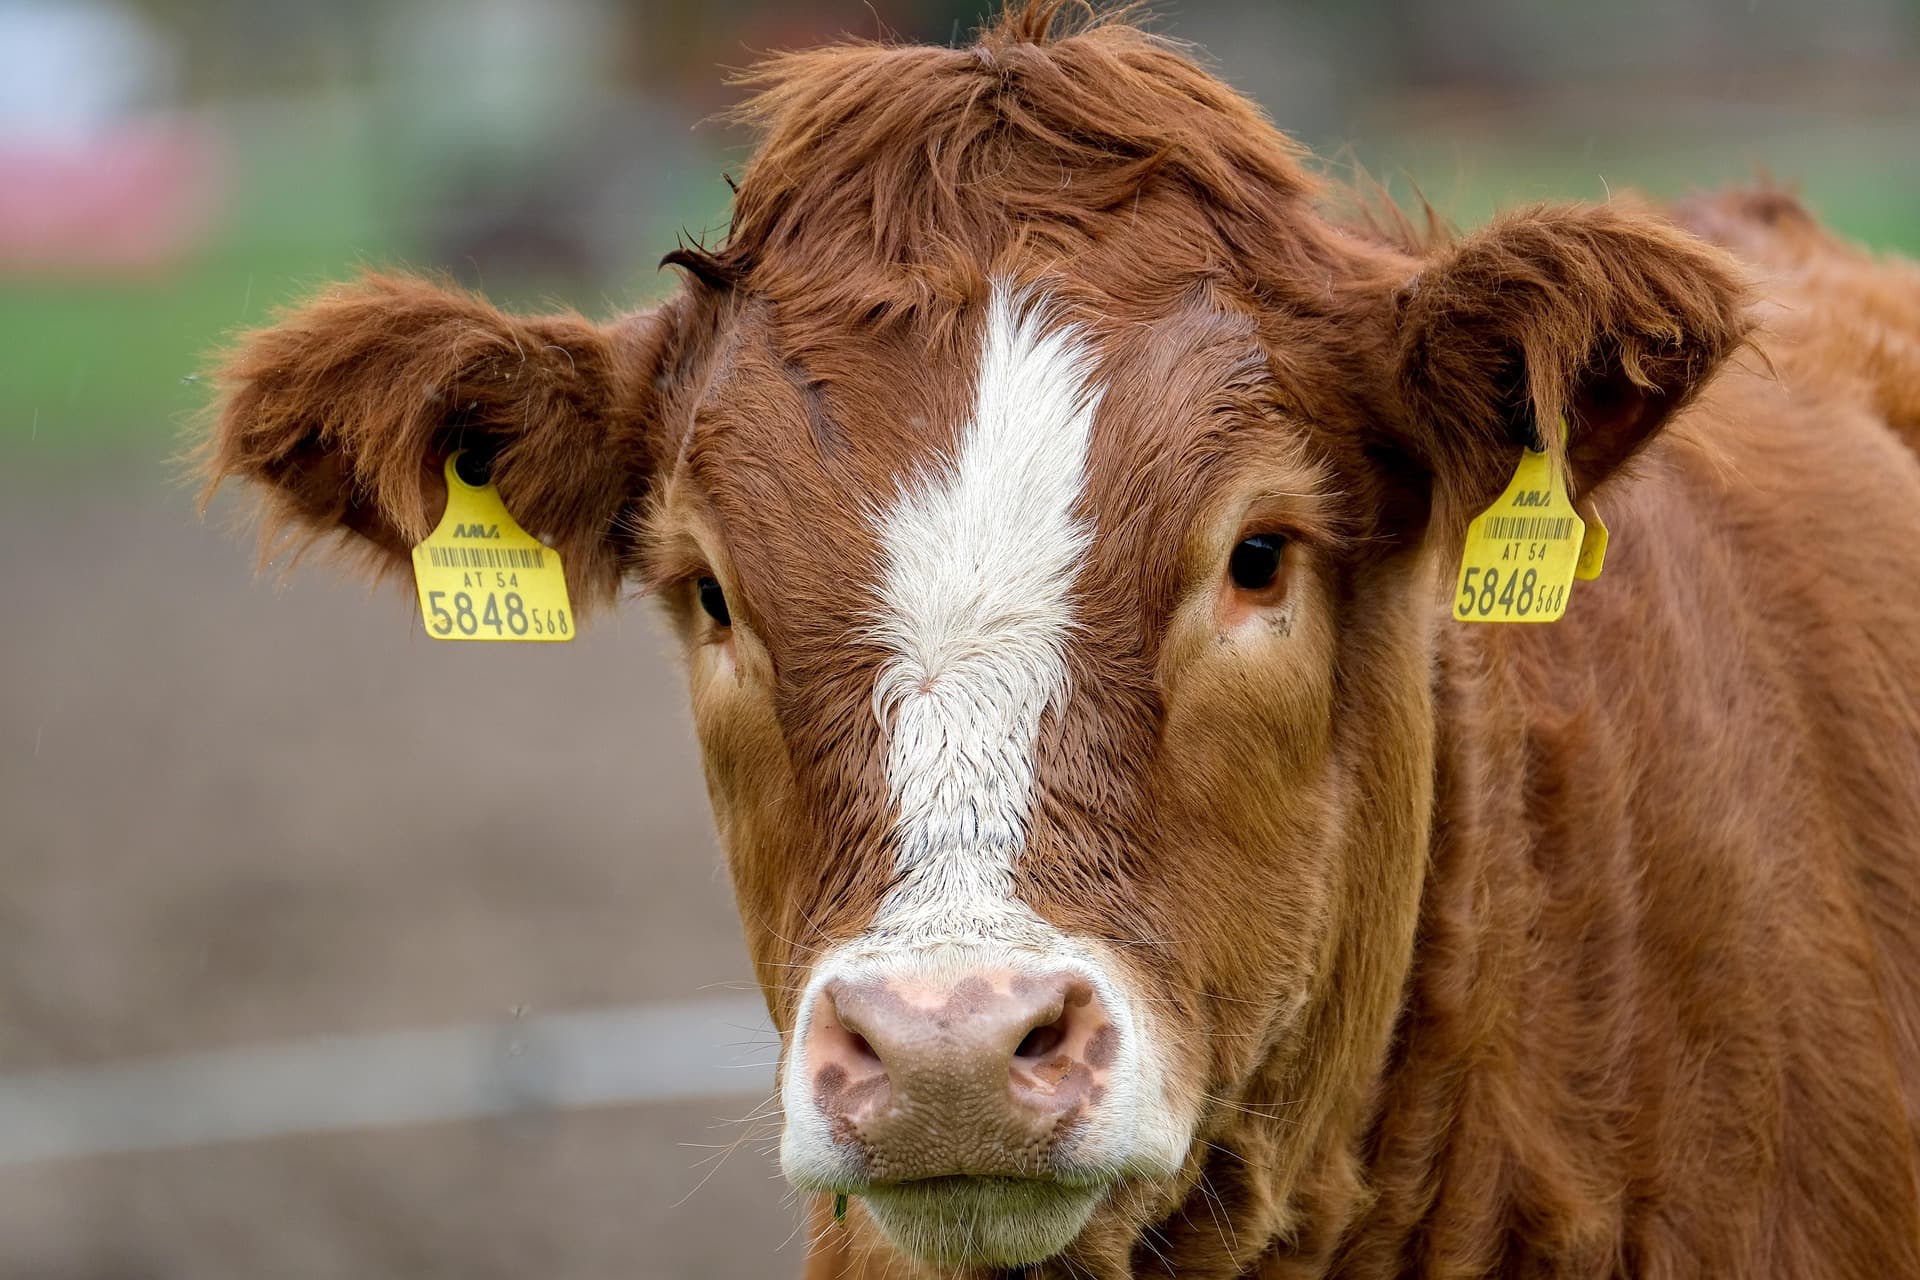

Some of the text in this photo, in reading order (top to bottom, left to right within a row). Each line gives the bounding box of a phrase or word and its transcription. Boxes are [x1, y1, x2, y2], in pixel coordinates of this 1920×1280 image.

[1502, 543, 1546, 561] AT 54
[464, 572, 518, 588] AT 54
[1458, 567, 1564, 616] 5848 568
[429, 591, 568, 636] 5848 568
